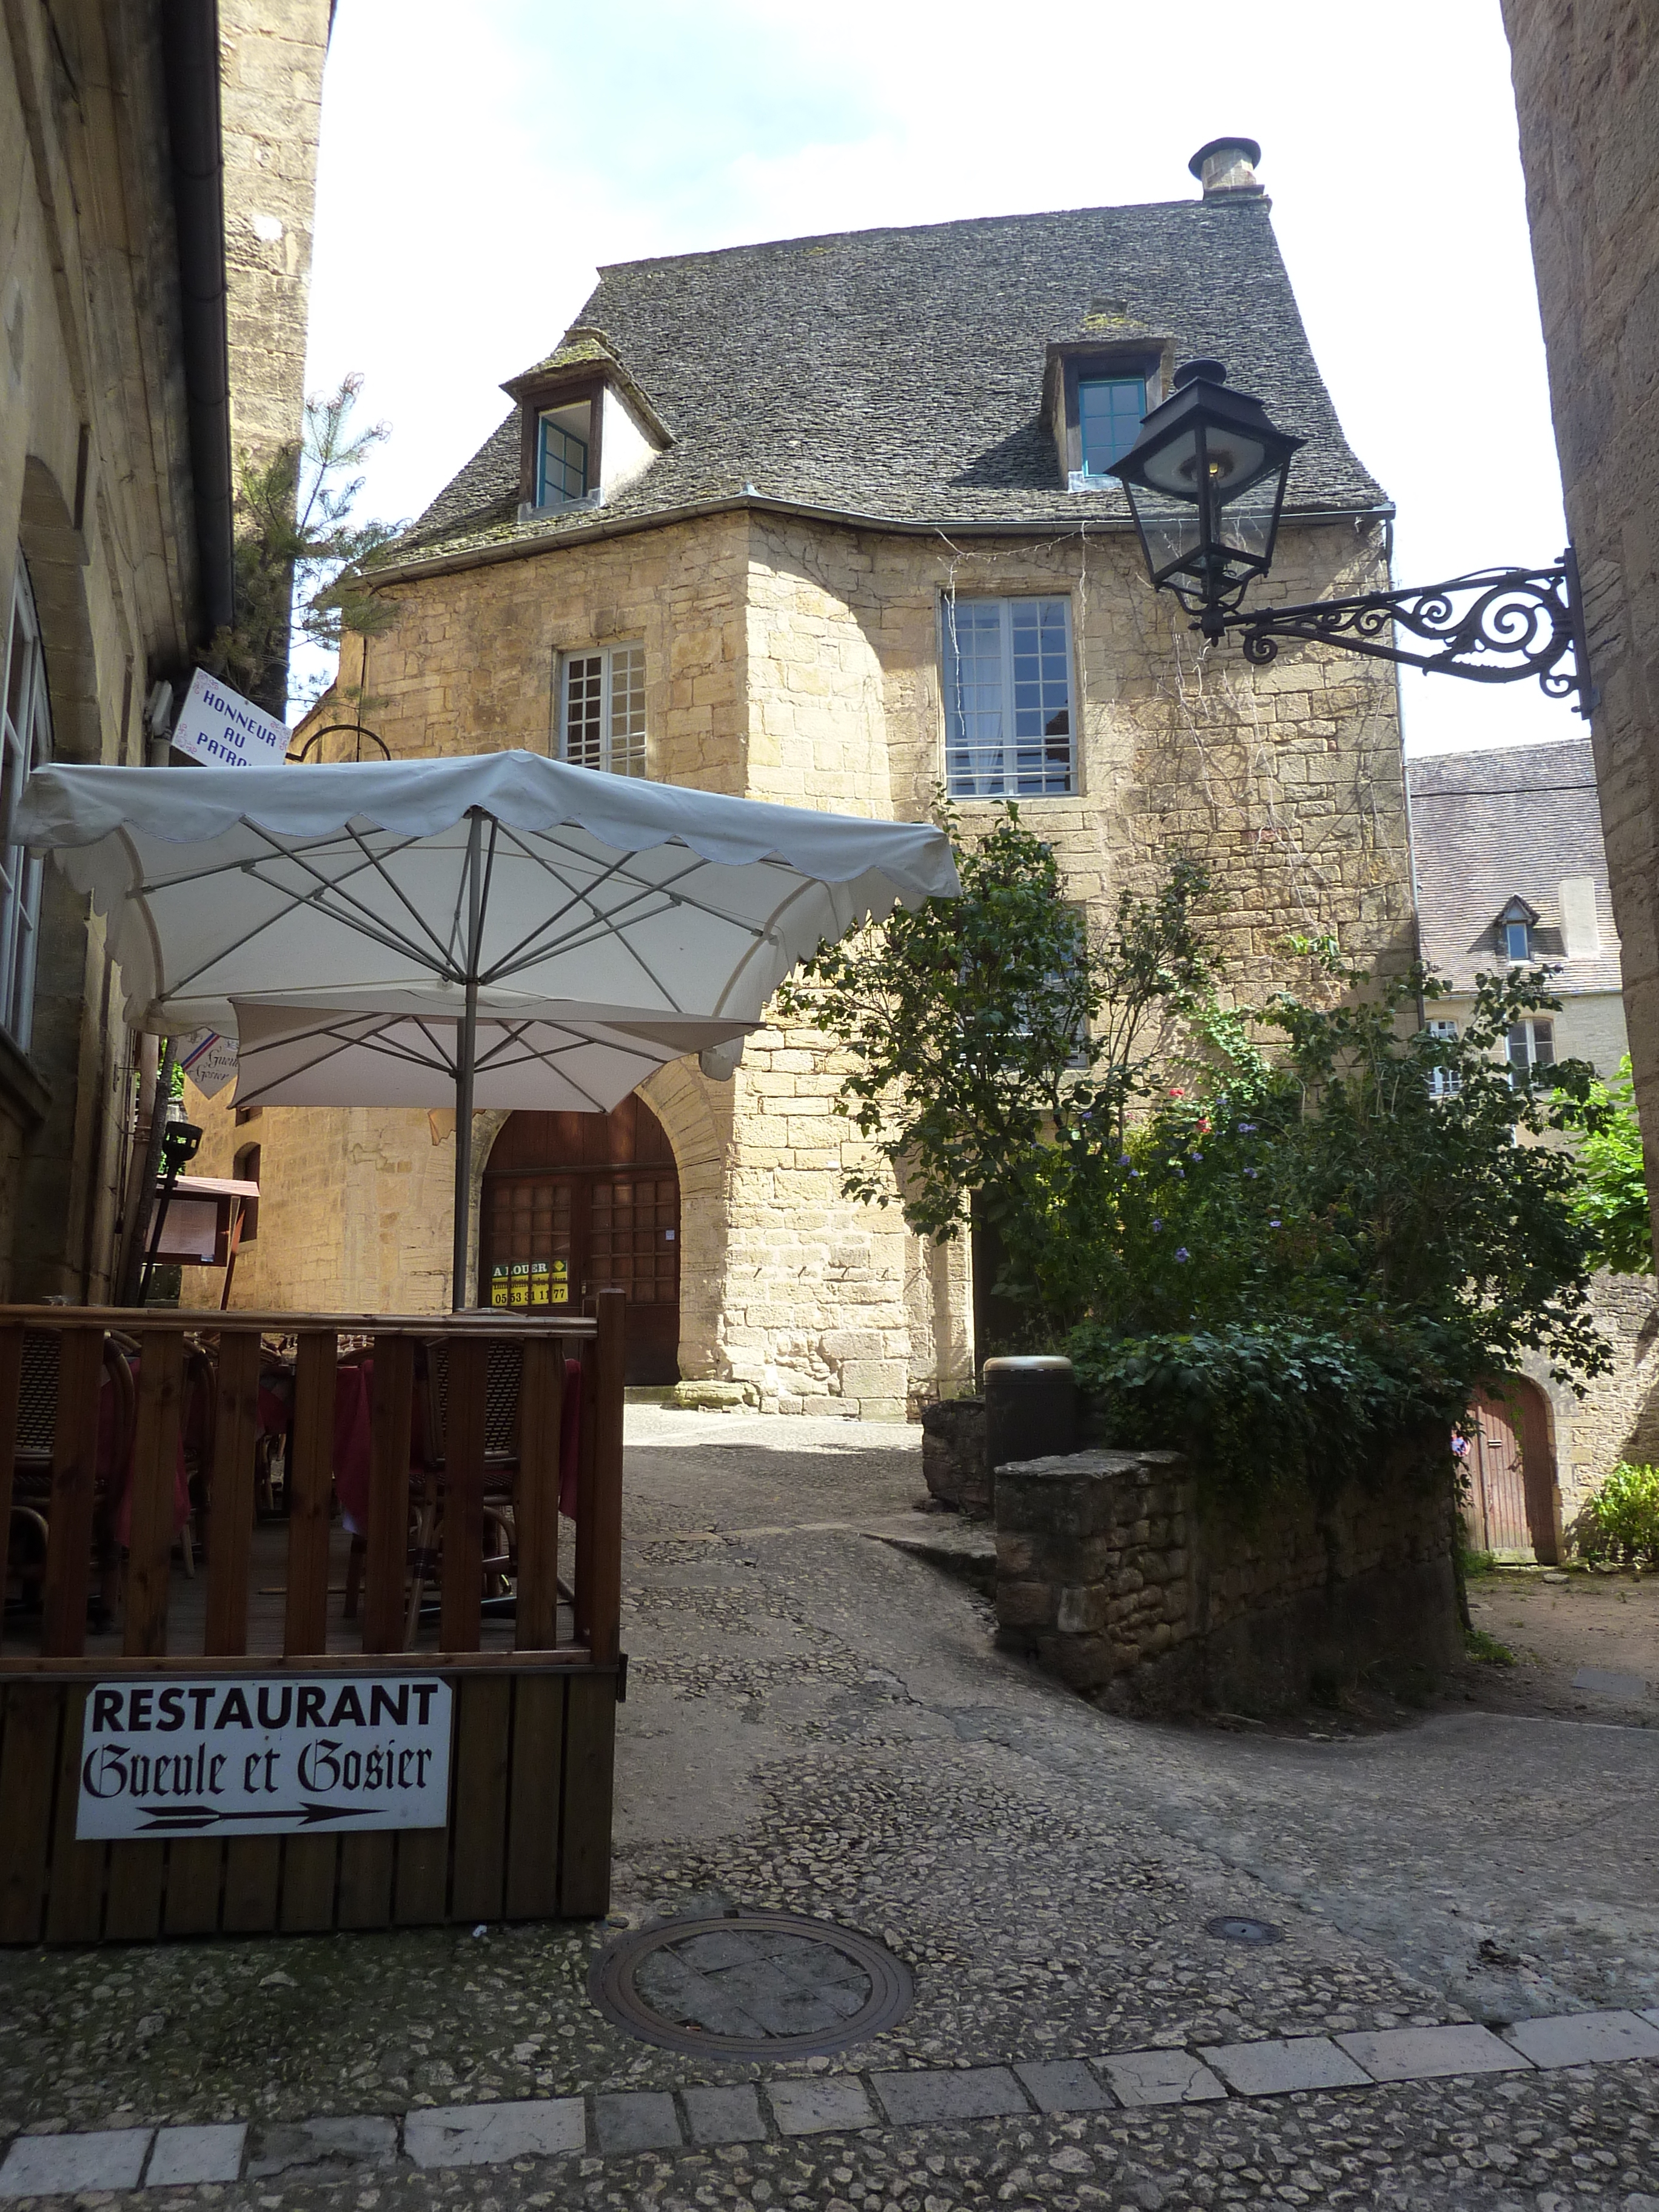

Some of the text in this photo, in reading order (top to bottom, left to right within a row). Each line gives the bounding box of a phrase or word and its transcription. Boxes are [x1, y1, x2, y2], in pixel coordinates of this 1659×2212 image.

[203, 689, 276, 747] HONNEUR
[196, 731, 253, 766] PATRO
[223, 726, 246, 748] AU
[493, 1267, 502, 1276] A
[495, 1289, 565, 1303] 05 53 31 11 77
[93, 1684, 438, 1732] RESTAURANT
[83, 1739, 432, 1798] Gueule et Gosier
